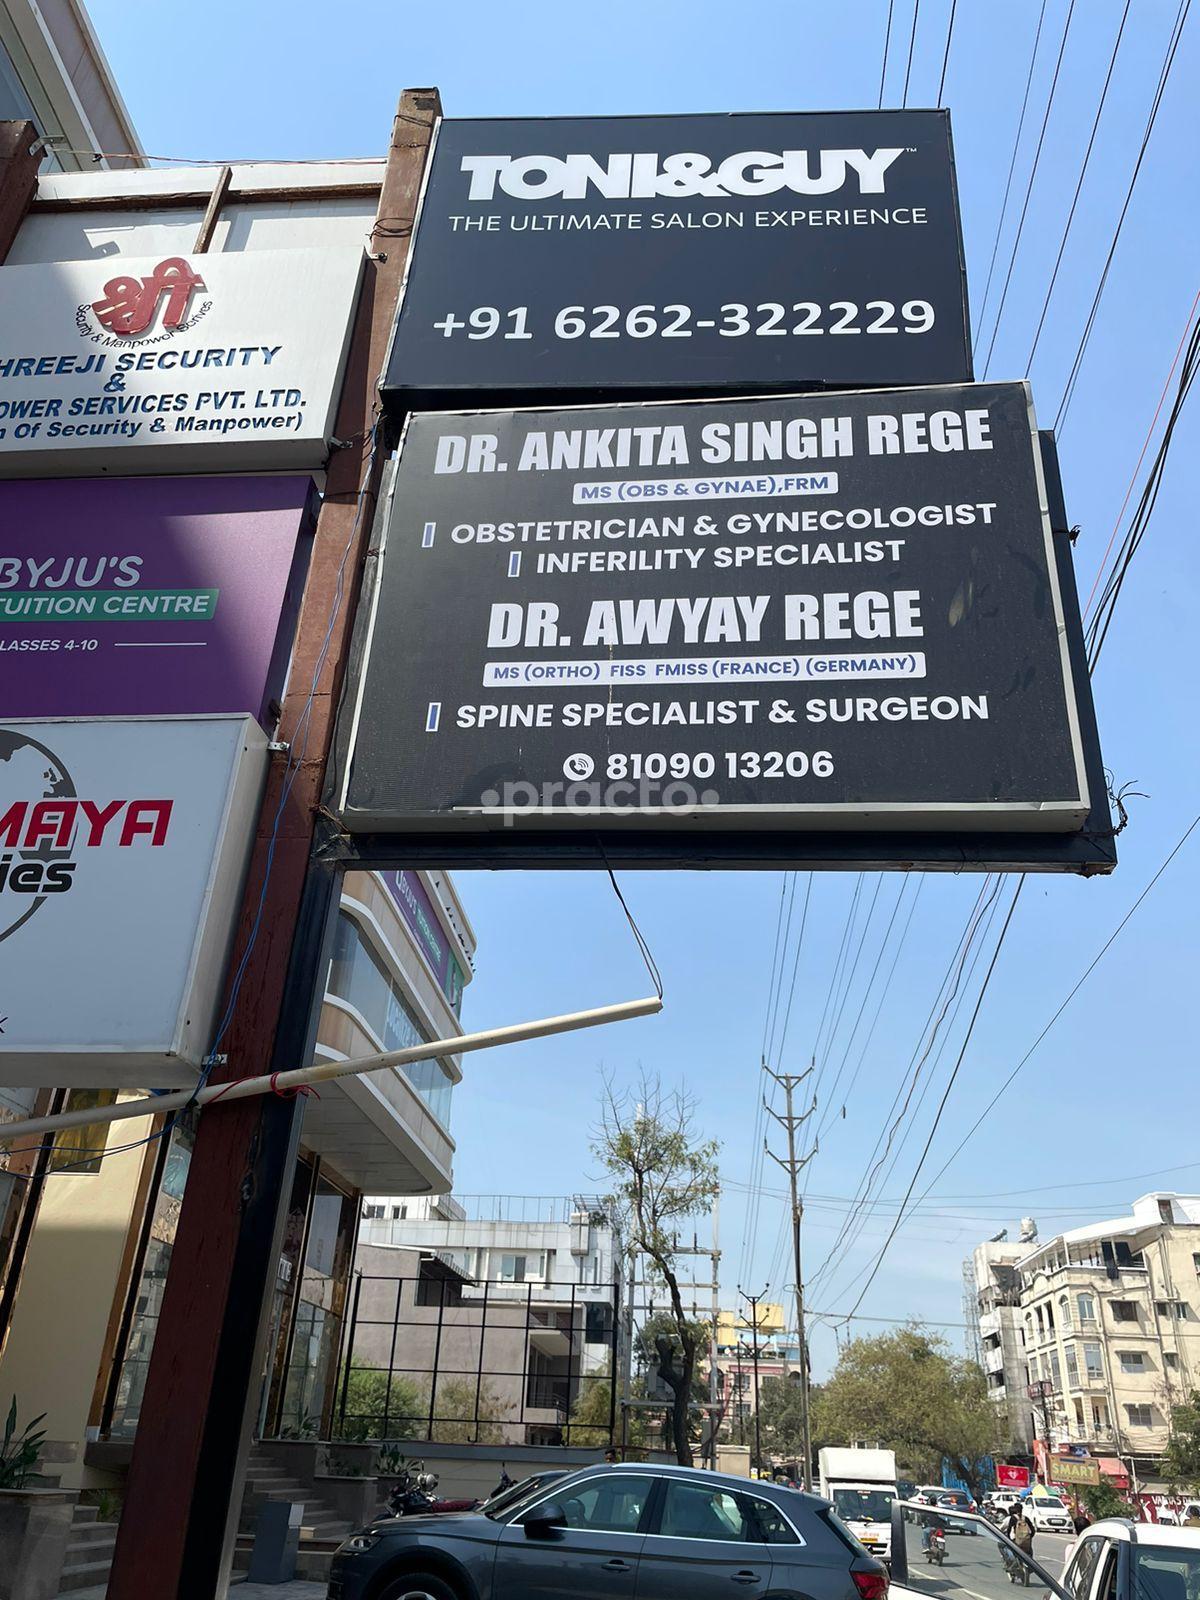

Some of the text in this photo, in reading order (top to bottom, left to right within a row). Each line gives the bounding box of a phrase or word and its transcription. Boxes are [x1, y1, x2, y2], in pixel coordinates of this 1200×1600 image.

[461, 148, 904, 200] TONI&GUY
[449, 208, 927, 231] THE ULTIMATE SALON EXPERIENCE
[434, 301, 934, 339] +91 6262-322229
[114, 346, 283, 371] SECURITY
[103, 373, 126, 392] &
[68, 391, 188, 416] SERVICES
[195, 391, 246, 411] PVT.
[255, 389, 307, 408] LTD.
[14, 422, 42, 439] Of
[47, 420, 143, 438] Security
[150, 418, 165, 433] &
[175, 413, 303, 434] Manpower)
[434, 409, 993, 475] DR. ANKITA SINGH REGE
[581, 485, 612, 499] MS
[617, 482, 668, 501] (OBS
[673, 484, 690, 496] &
[451, 503, 996, 544] OBSTETRICIAN & GYNECOLOGIST
[537, 540, 905, 574] INFERILITY SPECIALIST
[0, 556, 143, 588] BYJU'S
[104, 594, 210, 613] CENTRE
[487, 591, 923, 648] DR. AWYAY REGE
[64, 639, 98, 651] 4-10
[494, 655, 917, 681] MS (ORTHO) FISS FMISS (FRANCE) (GERMANY)
[457, 695, 989, 728] SPINE SPECIALIST & SURGEON
[607, 751, 834, 779] 81090 13206
[1052, 1463, 1095, 1477] SMART
